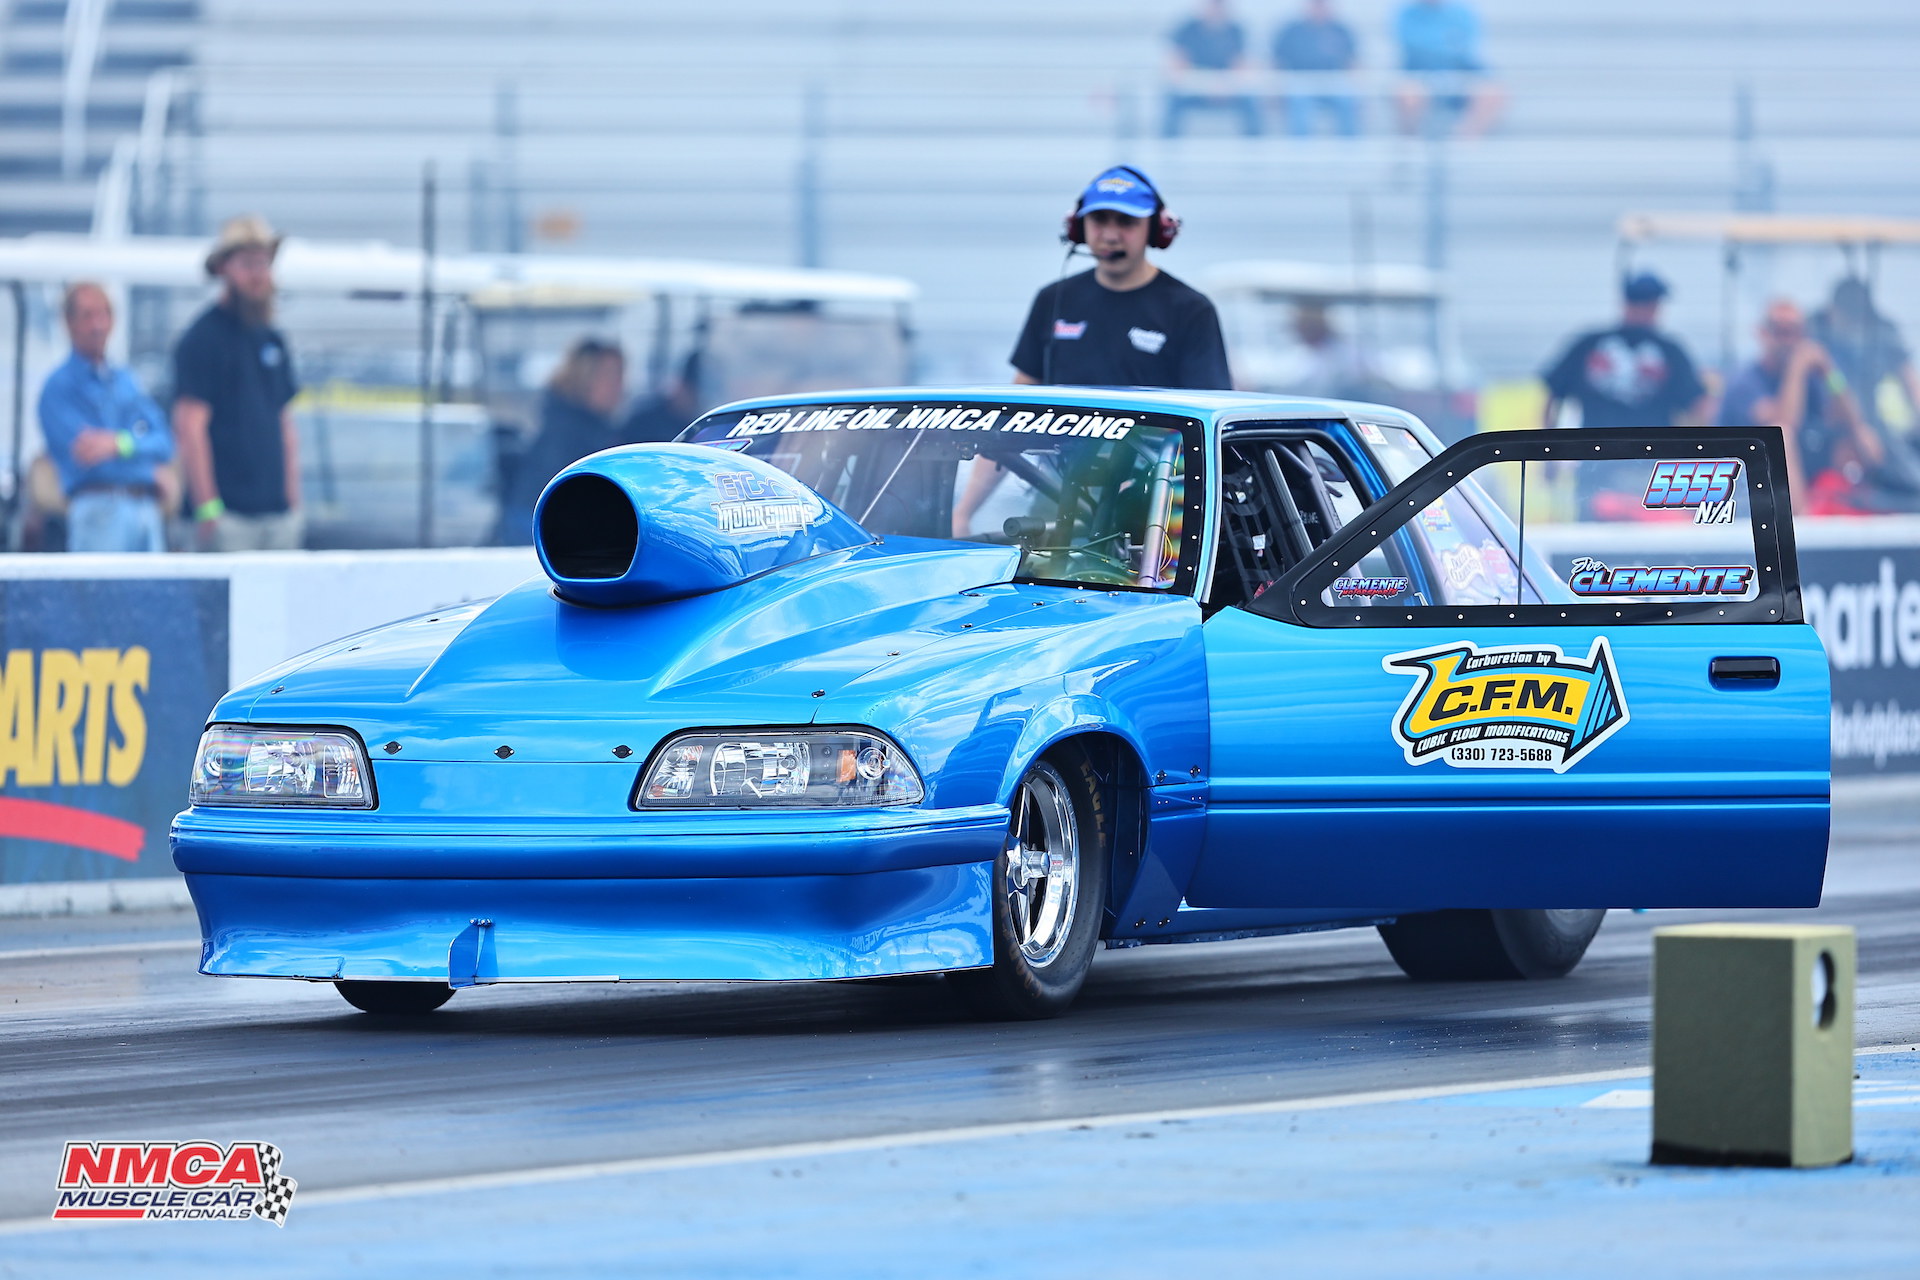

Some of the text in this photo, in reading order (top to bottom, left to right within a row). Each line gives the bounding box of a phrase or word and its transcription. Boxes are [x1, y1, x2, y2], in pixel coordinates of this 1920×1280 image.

[726, 407, 1135, 440] RED LINE OIL NMCA RACING
[1643, 461, 1741, 508] 5555
[1695, 501, 1734, 524] N/A
[1572, 557, 1605, 573] Joe
[1334, 578, 1408, 591] CLEMENTE
[1569, 566, 1754, 596] CLEMENTE
[1466, 652, 1551, 670] Carburetion by
[1429, 679, 1573, 721] C.F.M.
[1417, 724, 1570, 752] CUBIC FLOW MODIFICATIONS
[1451, 748, 1551, 762] (330) 723-5688
